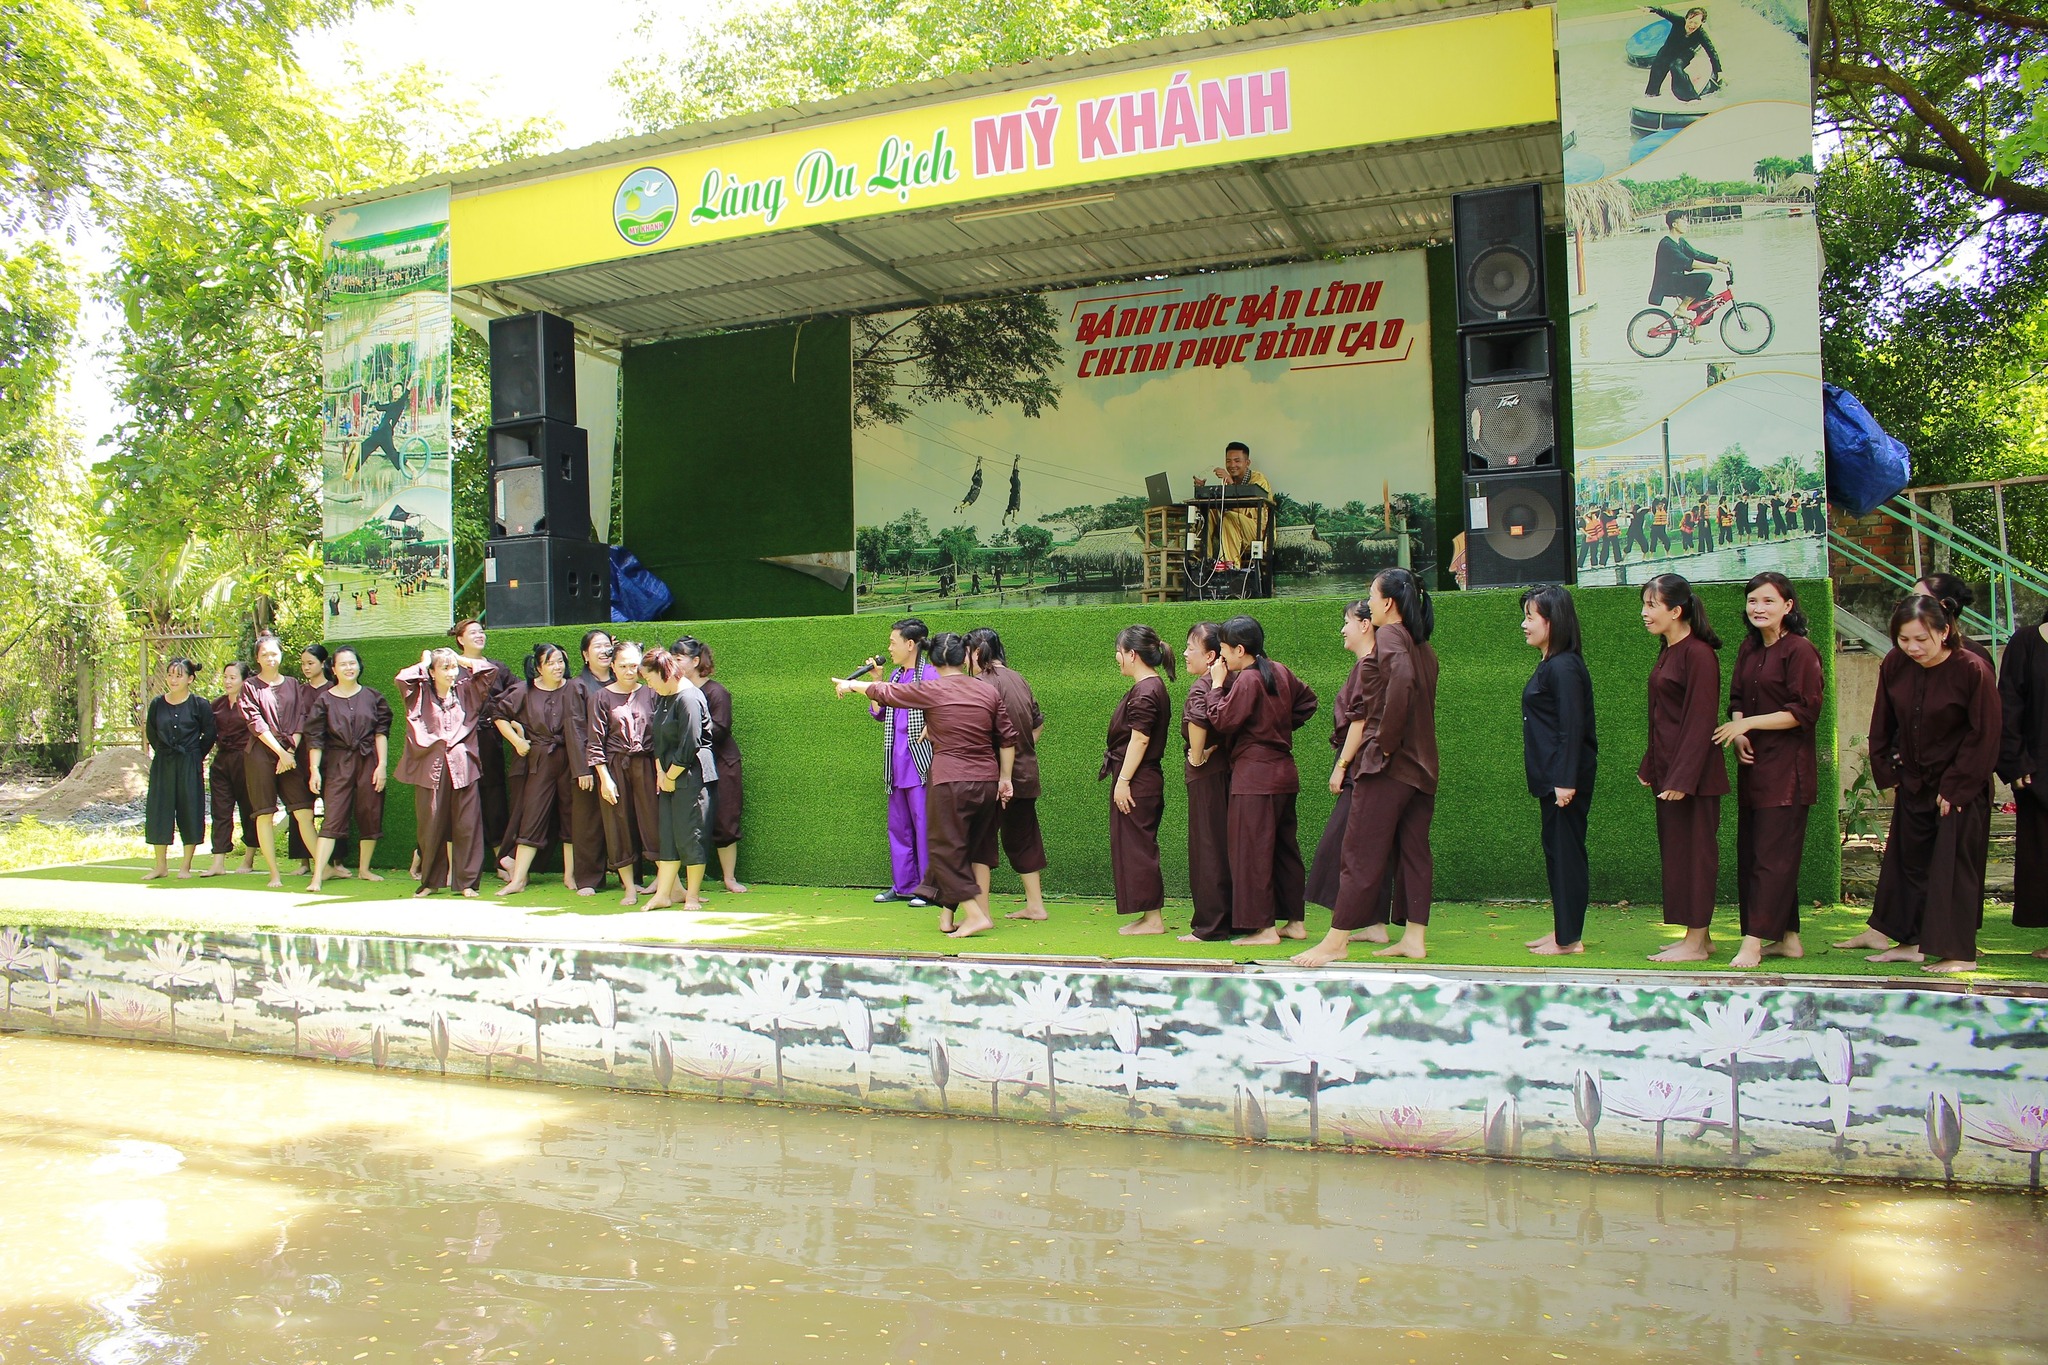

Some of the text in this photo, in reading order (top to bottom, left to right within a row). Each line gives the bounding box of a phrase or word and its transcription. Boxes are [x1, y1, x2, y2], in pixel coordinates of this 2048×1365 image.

[691, 71, 1288, 223] Làng Du Lịch MỸ KHÁNH
[1075, 280, 1384, 345] ĐÁNH THỨC BẢN LĨNH
[1077, 318, 1405, 378] CHINH PHỤC ĐỈNH CAO
